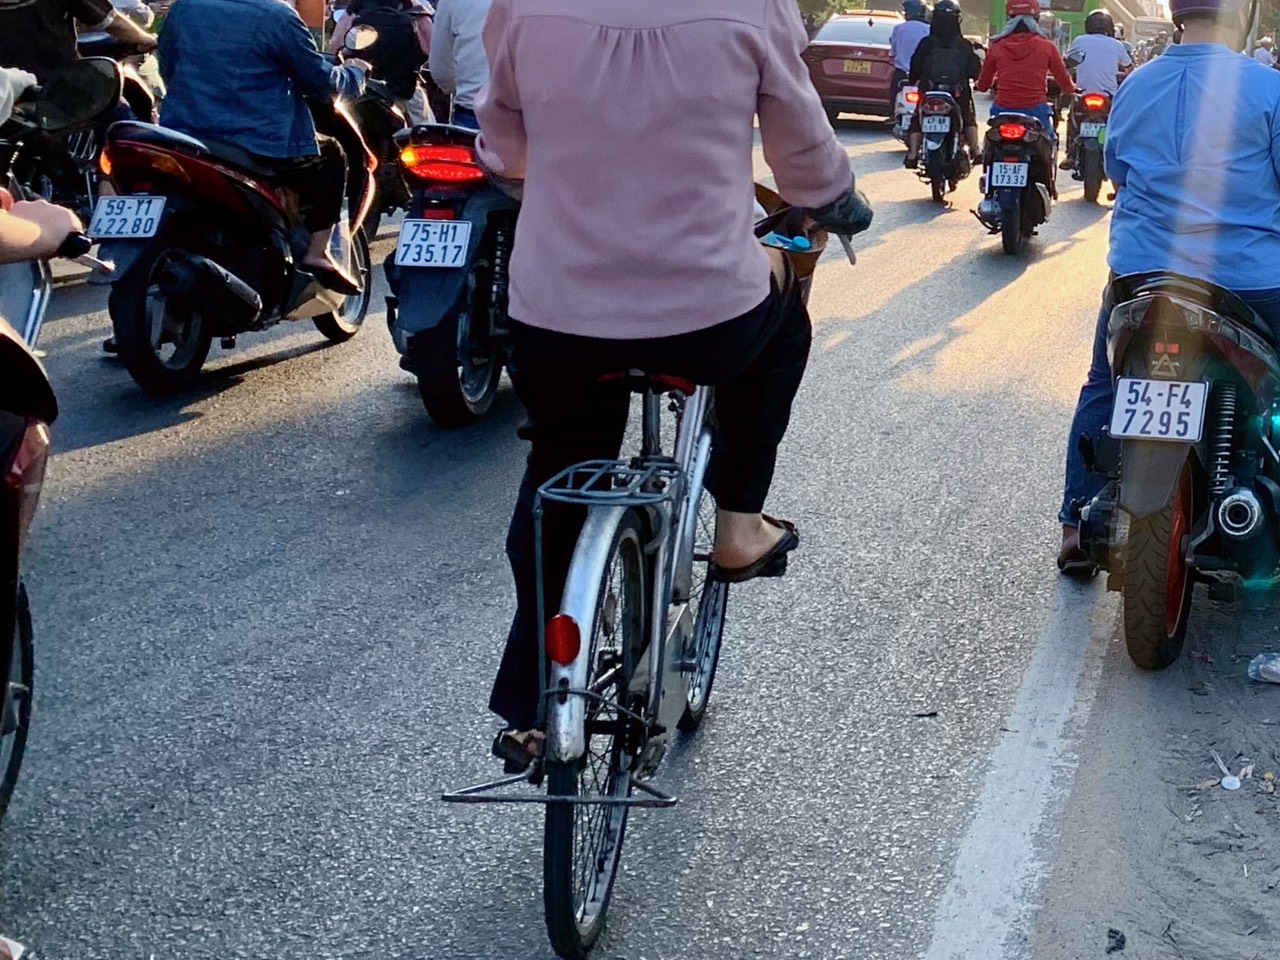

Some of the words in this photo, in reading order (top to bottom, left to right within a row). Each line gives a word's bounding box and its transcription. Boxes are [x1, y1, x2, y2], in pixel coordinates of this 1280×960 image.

[999, 164, 1023, 175] 15-AF
[995, 174, 1025, 185] 173.32
[105, 198, 153, 216] 59-Y1
[93, 217, 154, 235] 422.80
[410, 223, 457, 243] 75-H1
[400, 243, 463, 264] 735.17
[1126, 380, 1192, 409] 54-F4
[1122, 408, 1190, 437] 7295
